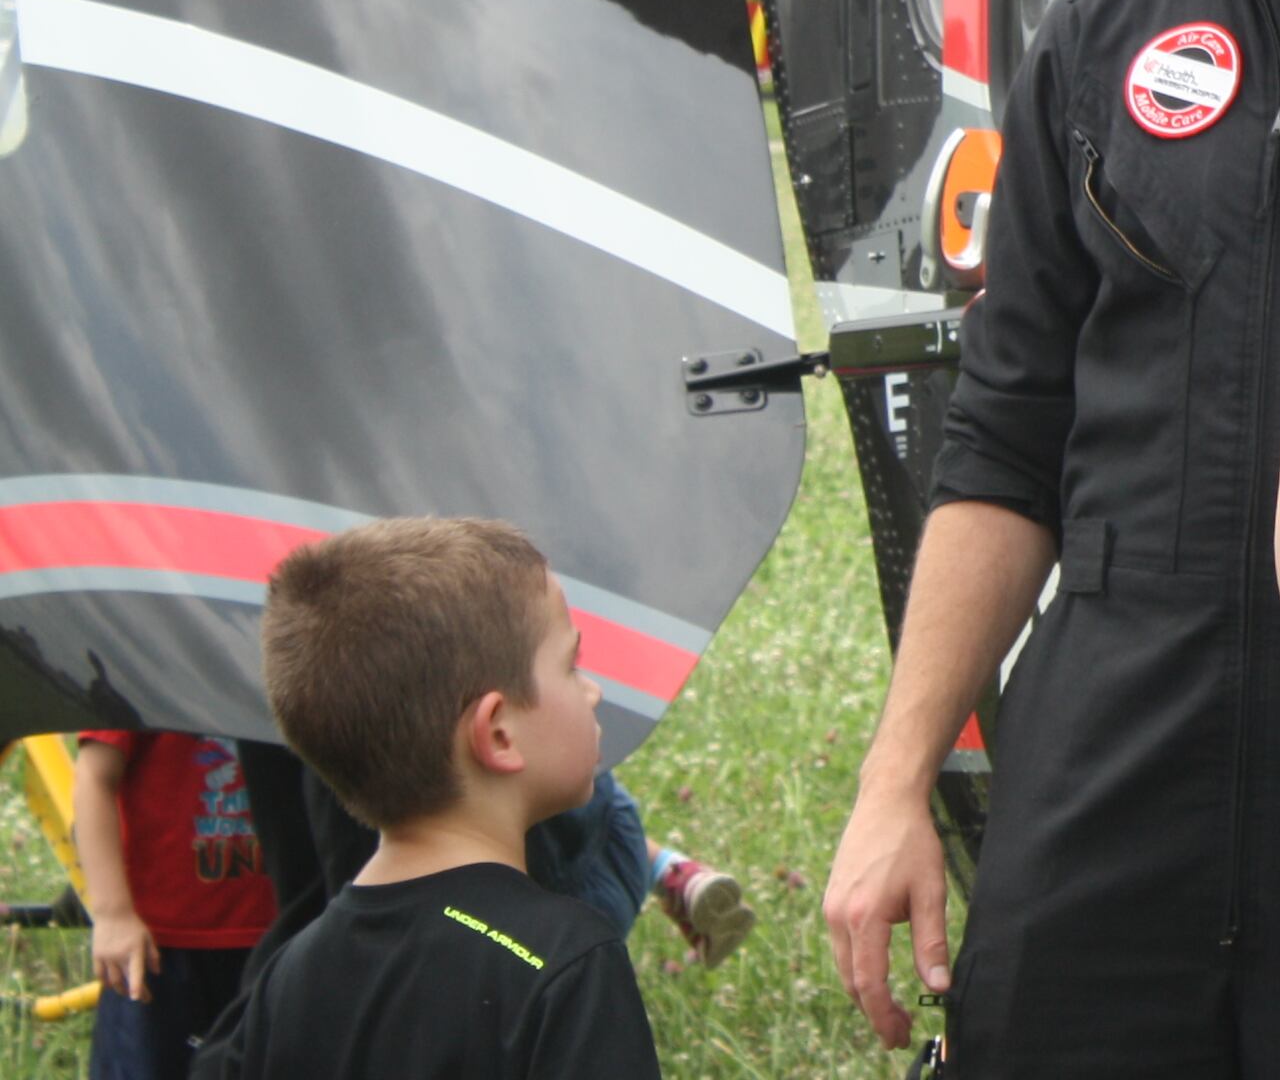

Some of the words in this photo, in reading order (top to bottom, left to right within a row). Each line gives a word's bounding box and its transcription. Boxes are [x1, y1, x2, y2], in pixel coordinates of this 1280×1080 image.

[1171, 109, 1204, 128] Care
[443, 906, 488, 934] UNDER
[486, 930, 544, 970] ARMOUR
